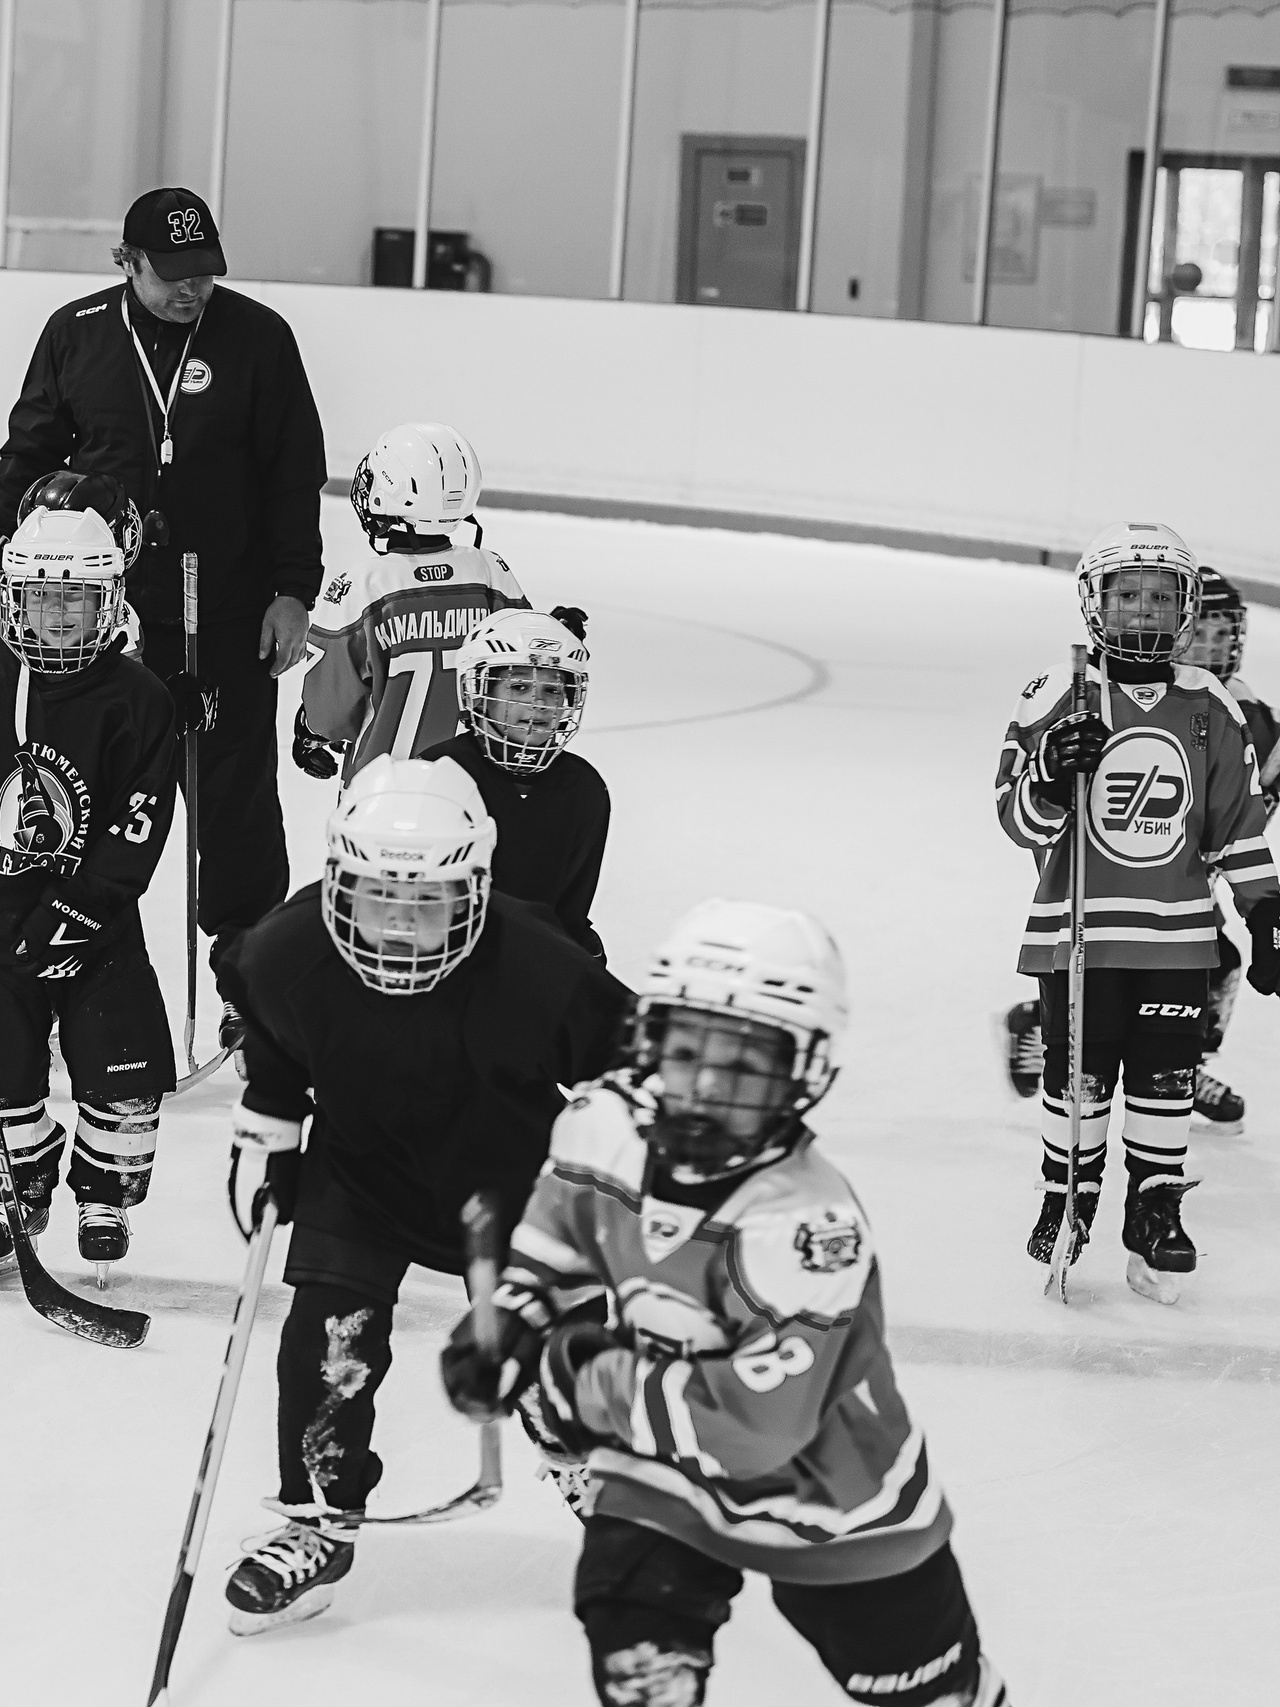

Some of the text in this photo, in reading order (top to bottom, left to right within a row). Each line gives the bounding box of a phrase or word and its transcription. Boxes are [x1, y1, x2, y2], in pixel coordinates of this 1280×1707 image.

[167, 207, 205, 245] 32
[75, 303, 107, 317] CCM
[1130, 543, 1170, 551] BAUER
[33, 553, 75, 562] BAUER
[419, 565, 449, 581] STOP
[387, 650, 460, 759] 7
[31, 741, 91, 851] ТЮМЕНСКИЙ
[1132, 818, 1172, 836] УБИН
[380, 849, 426, 862] Reebok
[51, 899, 103, 932] NORDWAY
[1137, 1002, 1202, 1019] CCM
[106, 1060, 148, 1073] NORDWAY
[846, 1641, 963, 1694] BAUER
